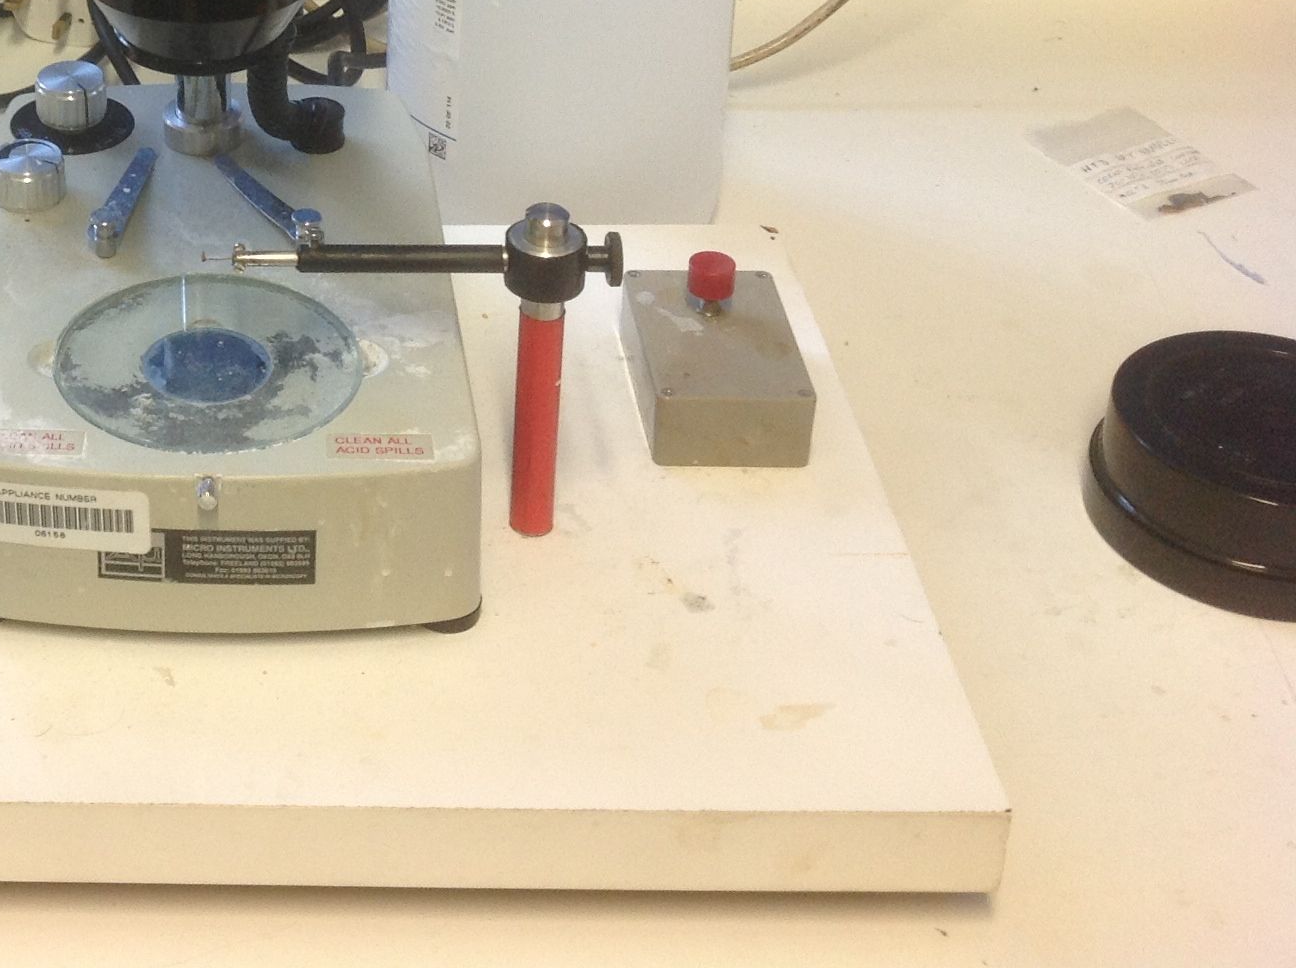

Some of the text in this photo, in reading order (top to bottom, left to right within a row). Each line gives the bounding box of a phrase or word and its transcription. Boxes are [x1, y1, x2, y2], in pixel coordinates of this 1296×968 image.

[335, 436, 412, 444] CLEAN ALL
[336, 446, 424, 455] ACID SPILLS
[54, 493, 97, 504] NUMBER
[34, 529, 66, 539] 06158
[182, 543, 214, 552] MICRO
[216, 544, 285, 553] INSTRUMENTS
